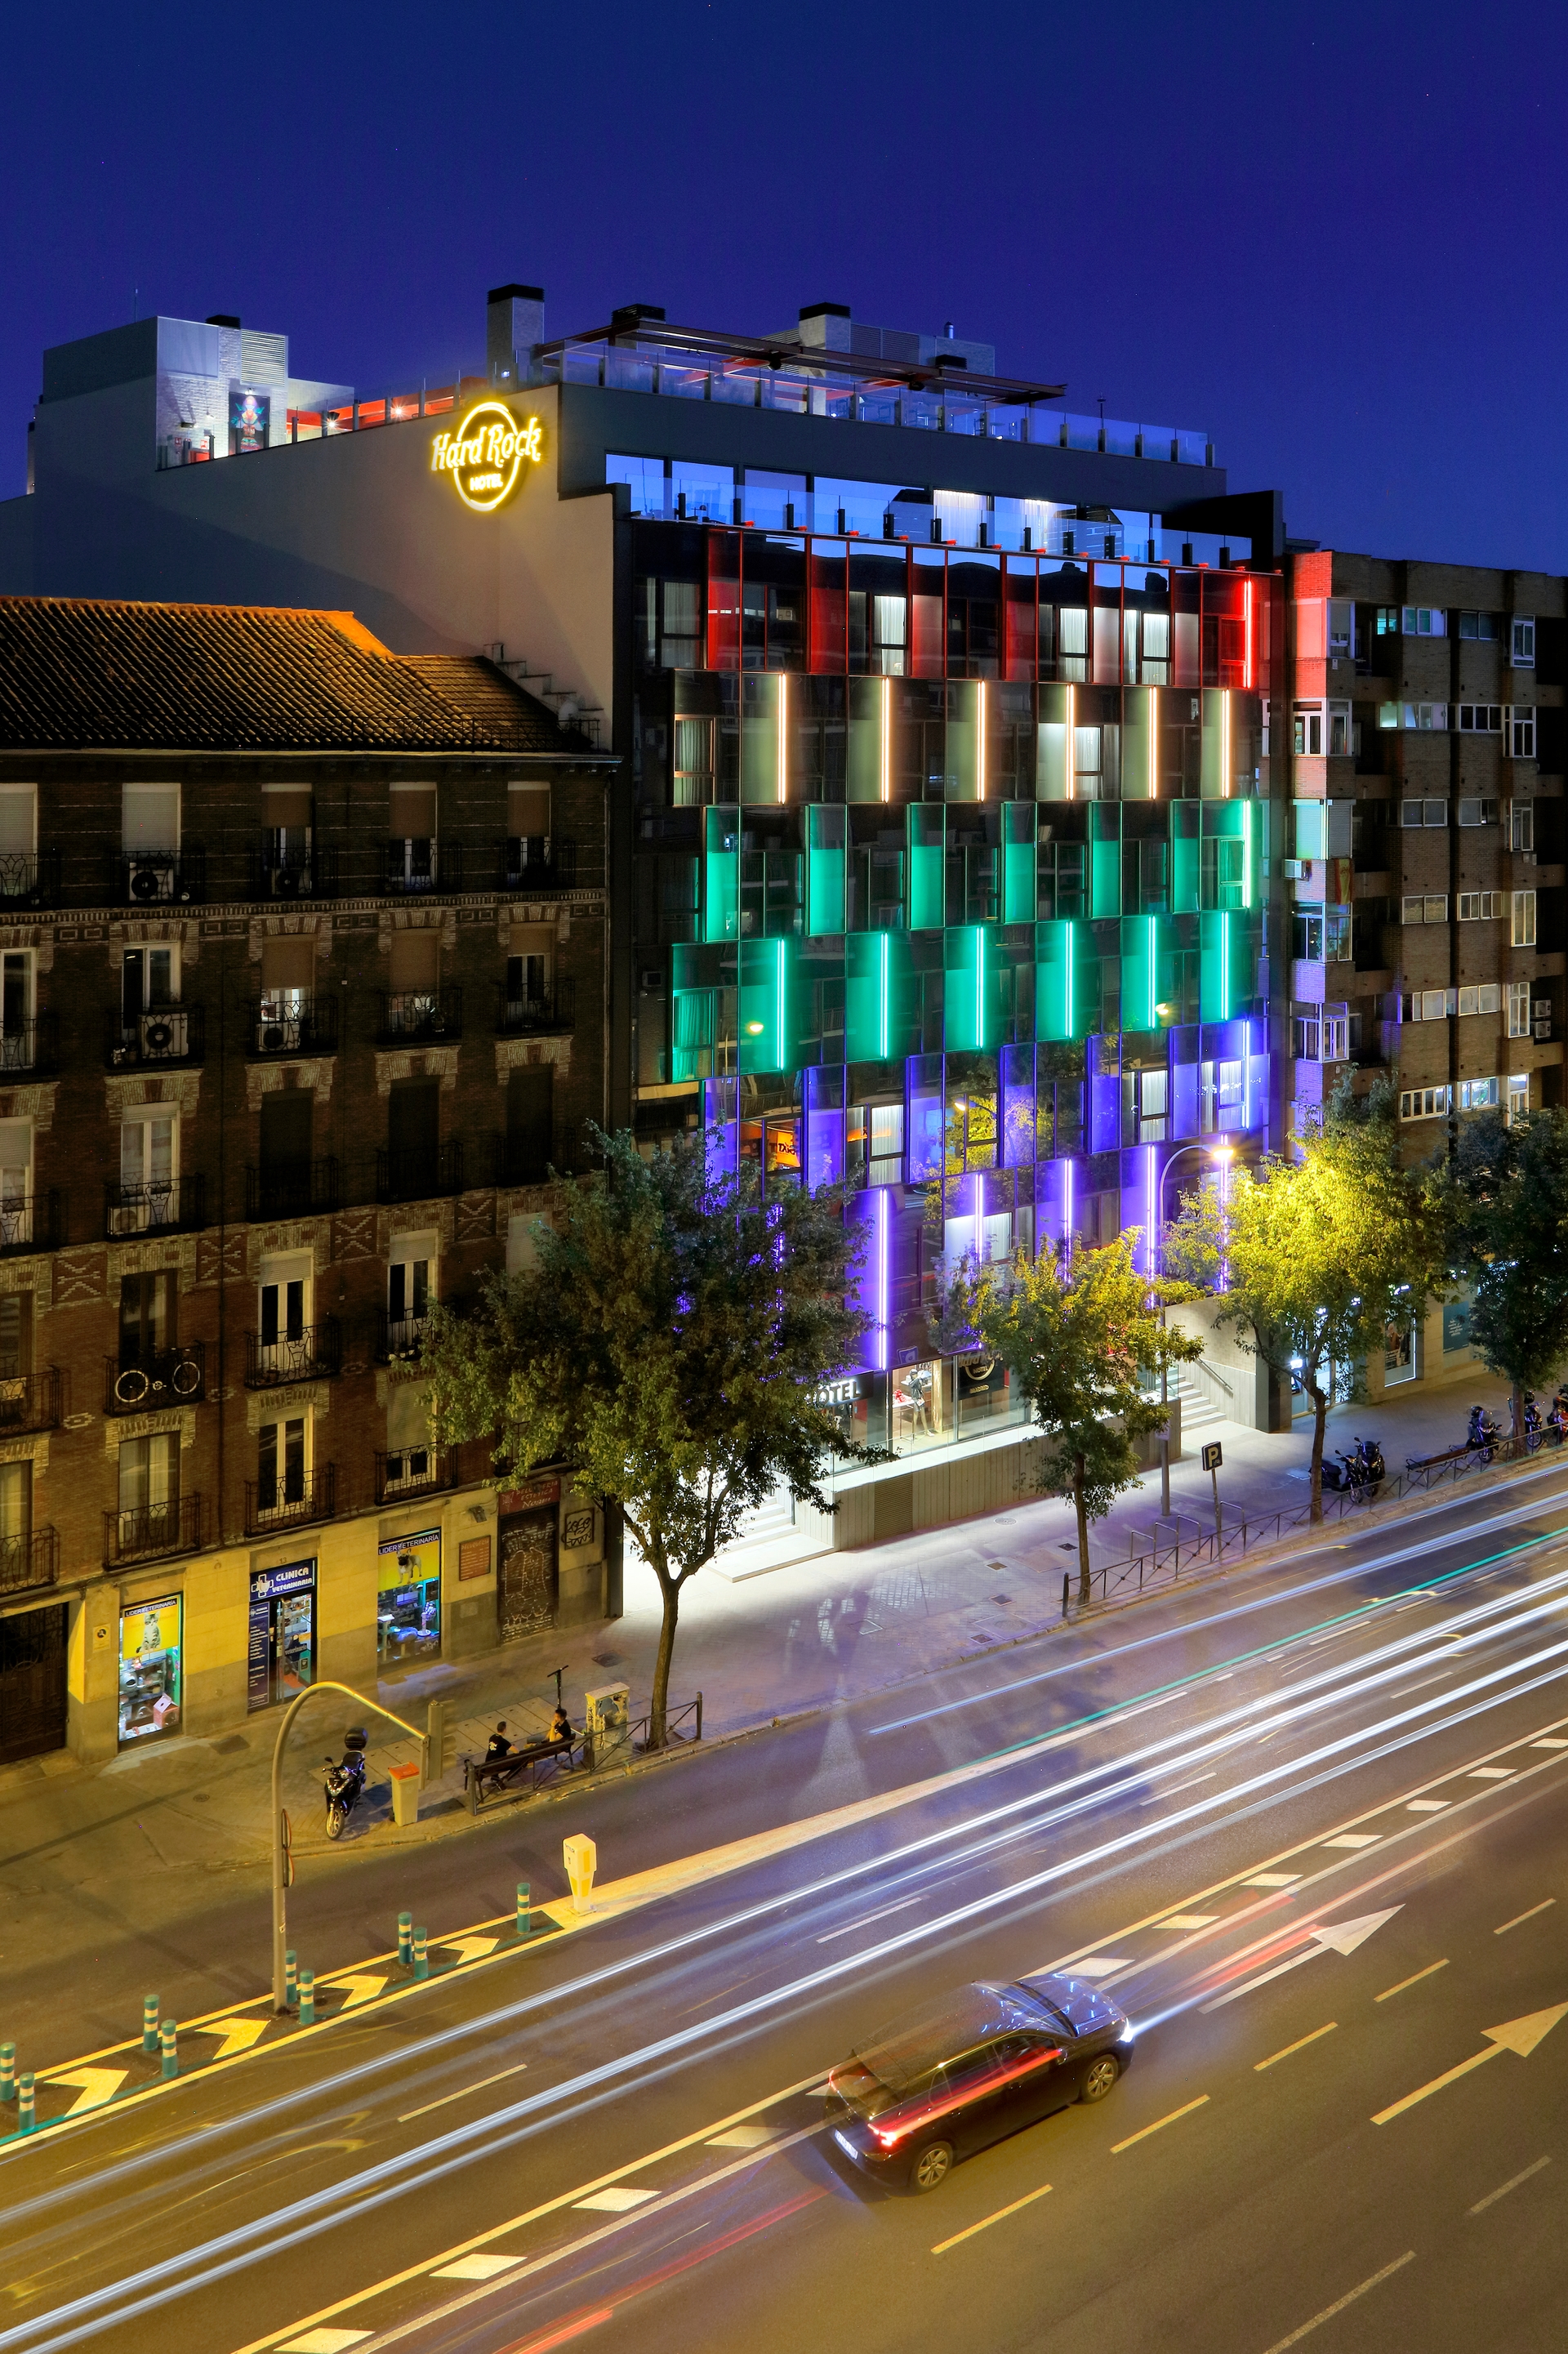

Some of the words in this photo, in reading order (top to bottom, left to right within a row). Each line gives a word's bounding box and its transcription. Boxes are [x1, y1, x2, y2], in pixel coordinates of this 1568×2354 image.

[431, 426, 488, 471] Hard
[486, 417, 541, 468] Rock
[470, 473, 504, 491] HOTEL
[808, 1380, 862, 1406] OTEL
[1208, 1447, 1218, 1468] P
[516, 1481, 559, 1496] PELUERIA
